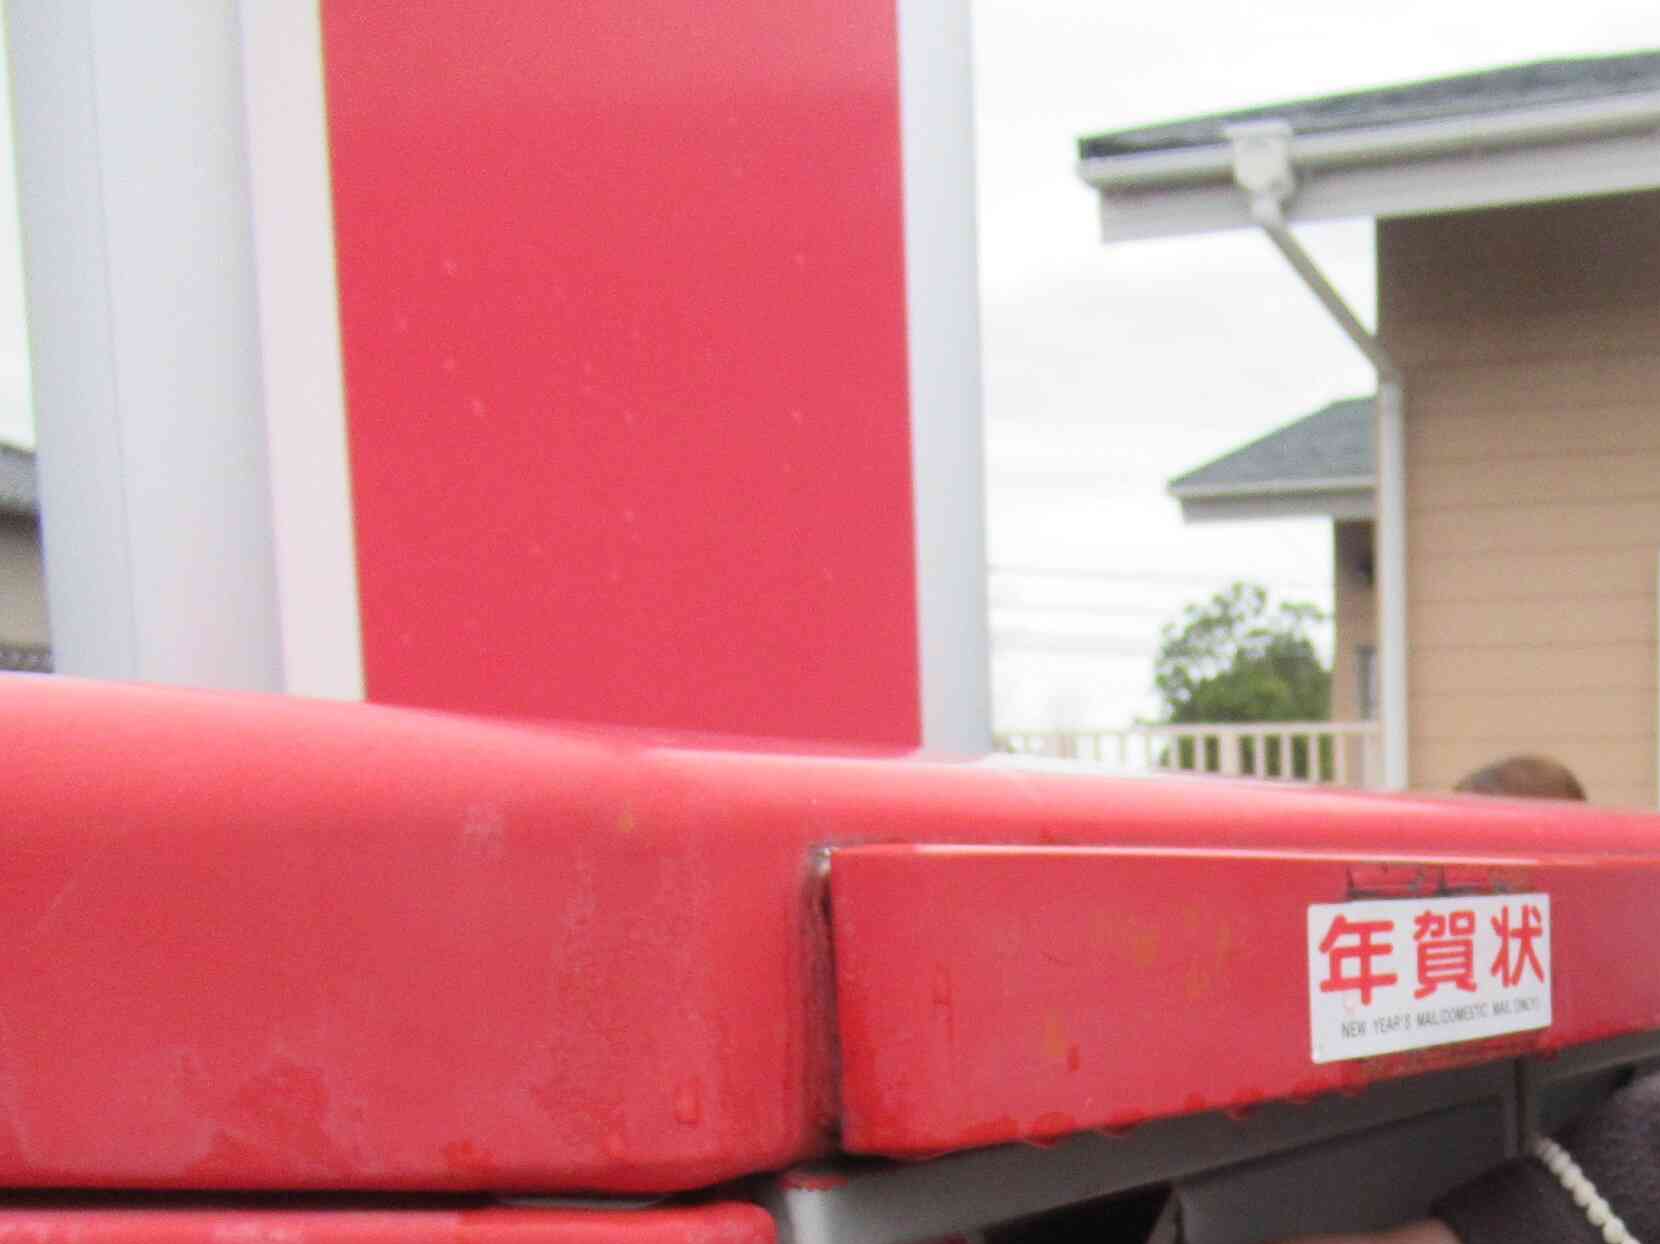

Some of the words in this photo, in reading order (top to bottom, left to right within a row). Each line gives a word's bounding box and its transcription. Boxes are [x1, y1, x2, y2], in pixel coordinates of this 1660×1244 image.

[1319, 905, 1545, 1007] 年賀状
[1341, 1019, 1367, 1039] NEW
